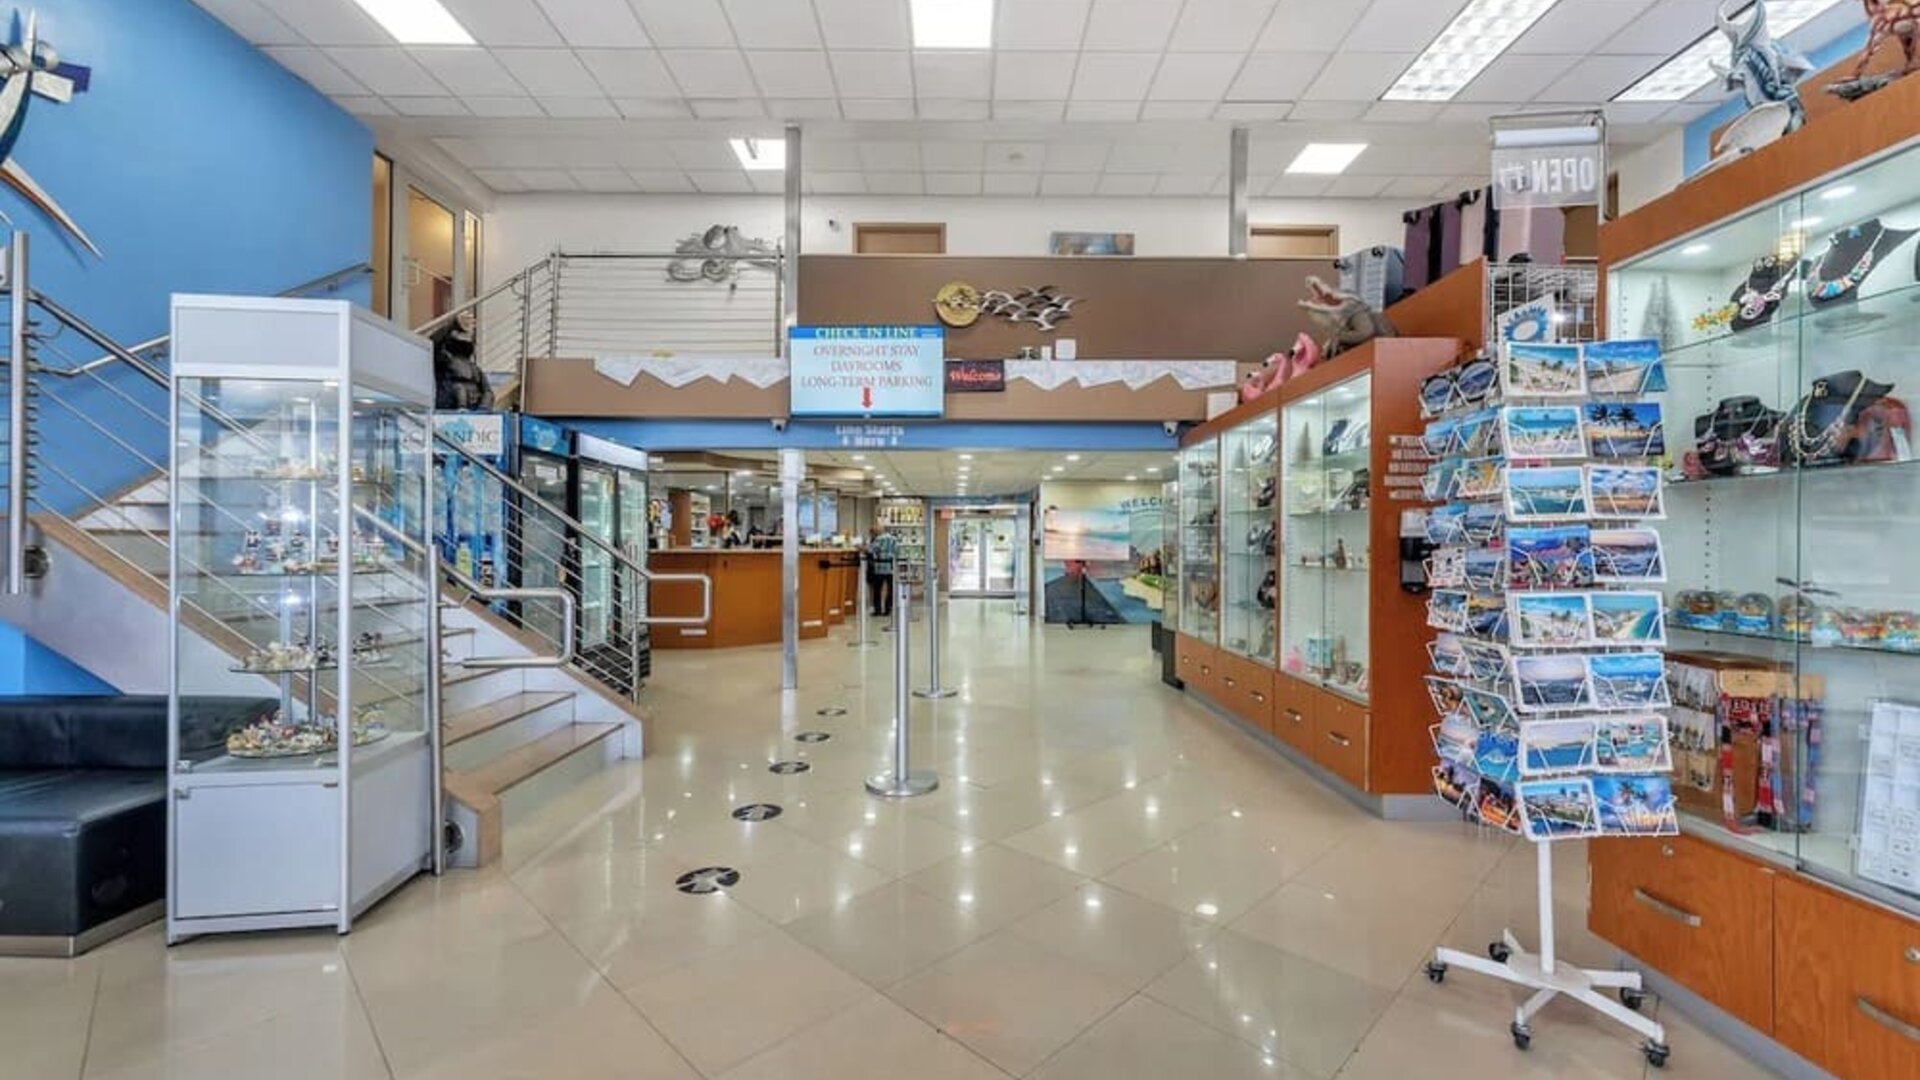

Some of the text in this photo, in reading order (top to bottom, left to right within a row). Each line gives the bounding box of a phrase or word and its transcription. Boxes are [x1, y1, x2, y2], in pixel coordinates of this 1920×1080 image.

[886, 327, 916, 338] LINE
[813, 345, 920, 357] OVERNIGHT STAY
[831, 360, 902, 372] DAYROOMS
[950, 366, 1002, 382] Welcome
[801, 375, 933, 387] LONG-TERM PARKING
[864, 425, 904, 436] Starts
